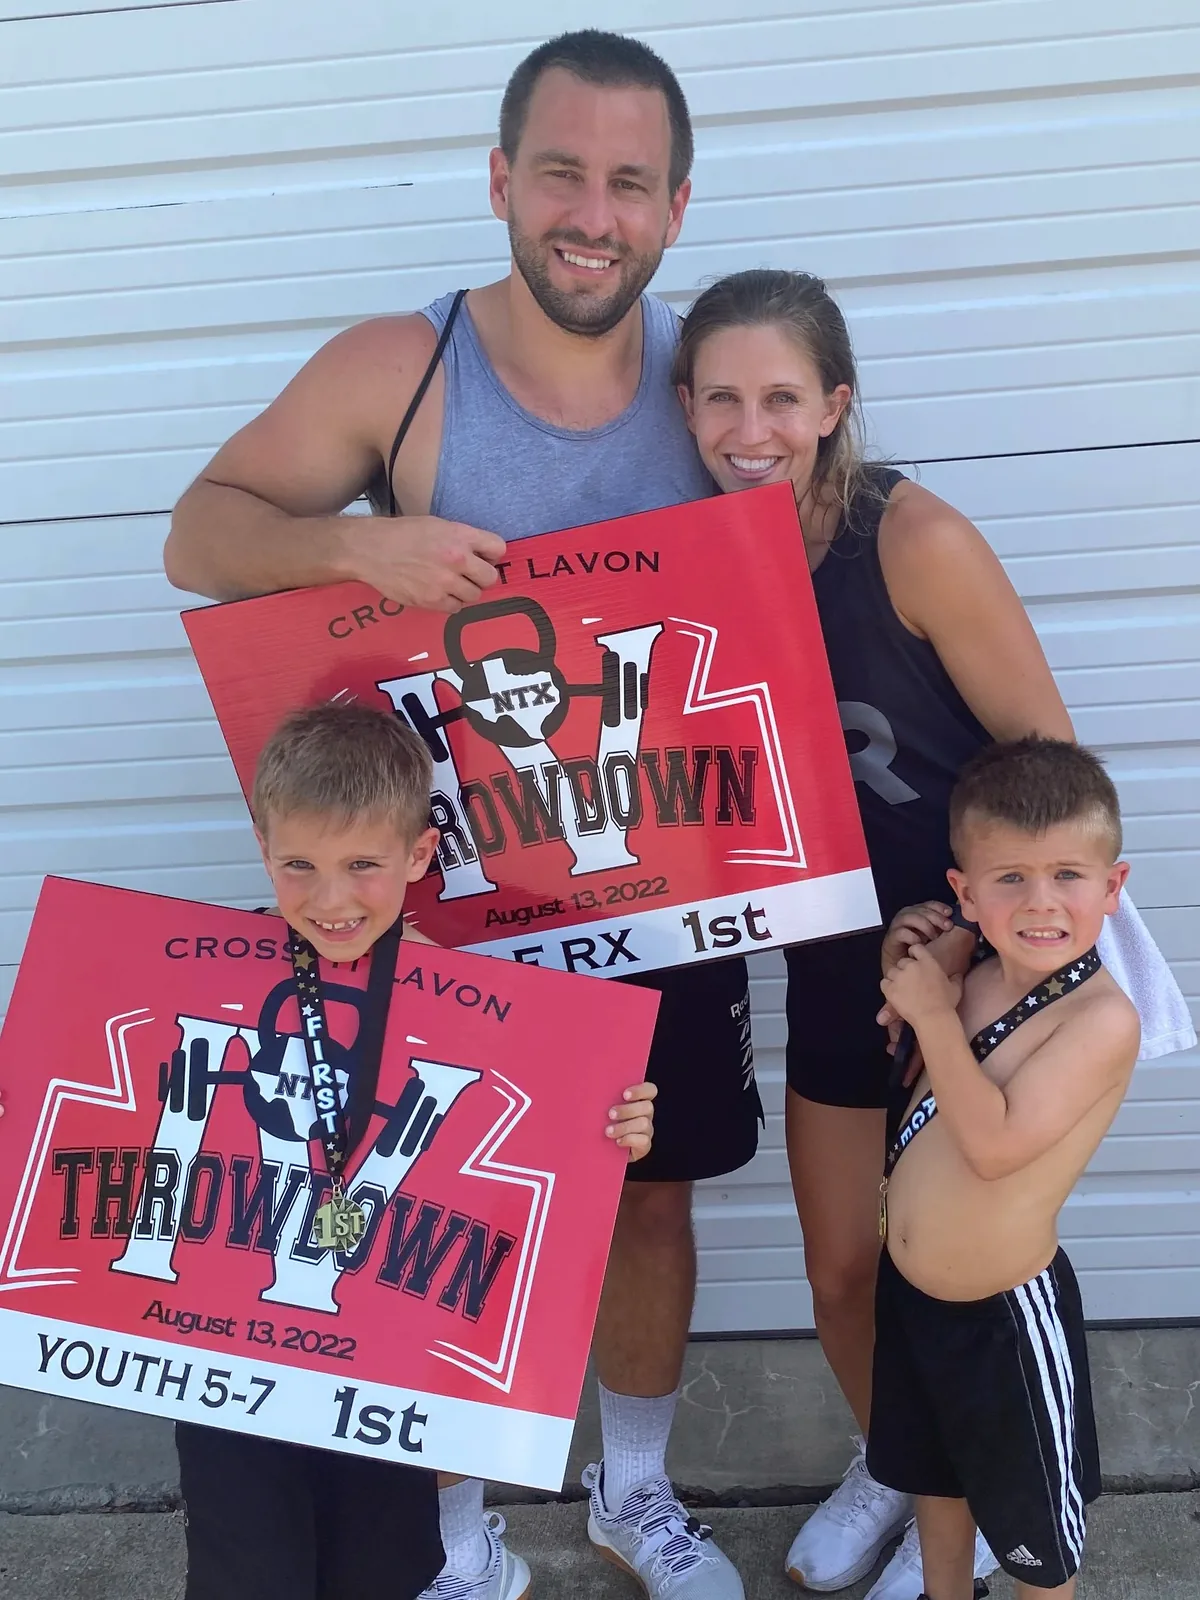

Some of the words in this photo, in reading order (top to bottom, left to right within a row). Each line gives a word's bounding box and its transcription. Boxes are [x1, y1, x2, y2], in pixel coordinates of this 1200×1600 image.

[527, 551, 660, 580] LAVON
[493, 682, 557, 714] NTX
[424, 746, 758, 876] ROWDOWN
[485, 898, 566, 928] August
[560, 928, 641, 973] RX
[682, 902, 773, 953] 1st
[393, 966, 512, 1023] AVON
[306, 1016, 339, 1133] FIRST
[314, 1202, 366, 1249] 1ST
[141, 1300, 237, 1338] August
[37, 1332, 193, 1401] YOUTH
[198, 1367, 277, 1416] 5-7
[331, 1386, 429, 1454] 1st
